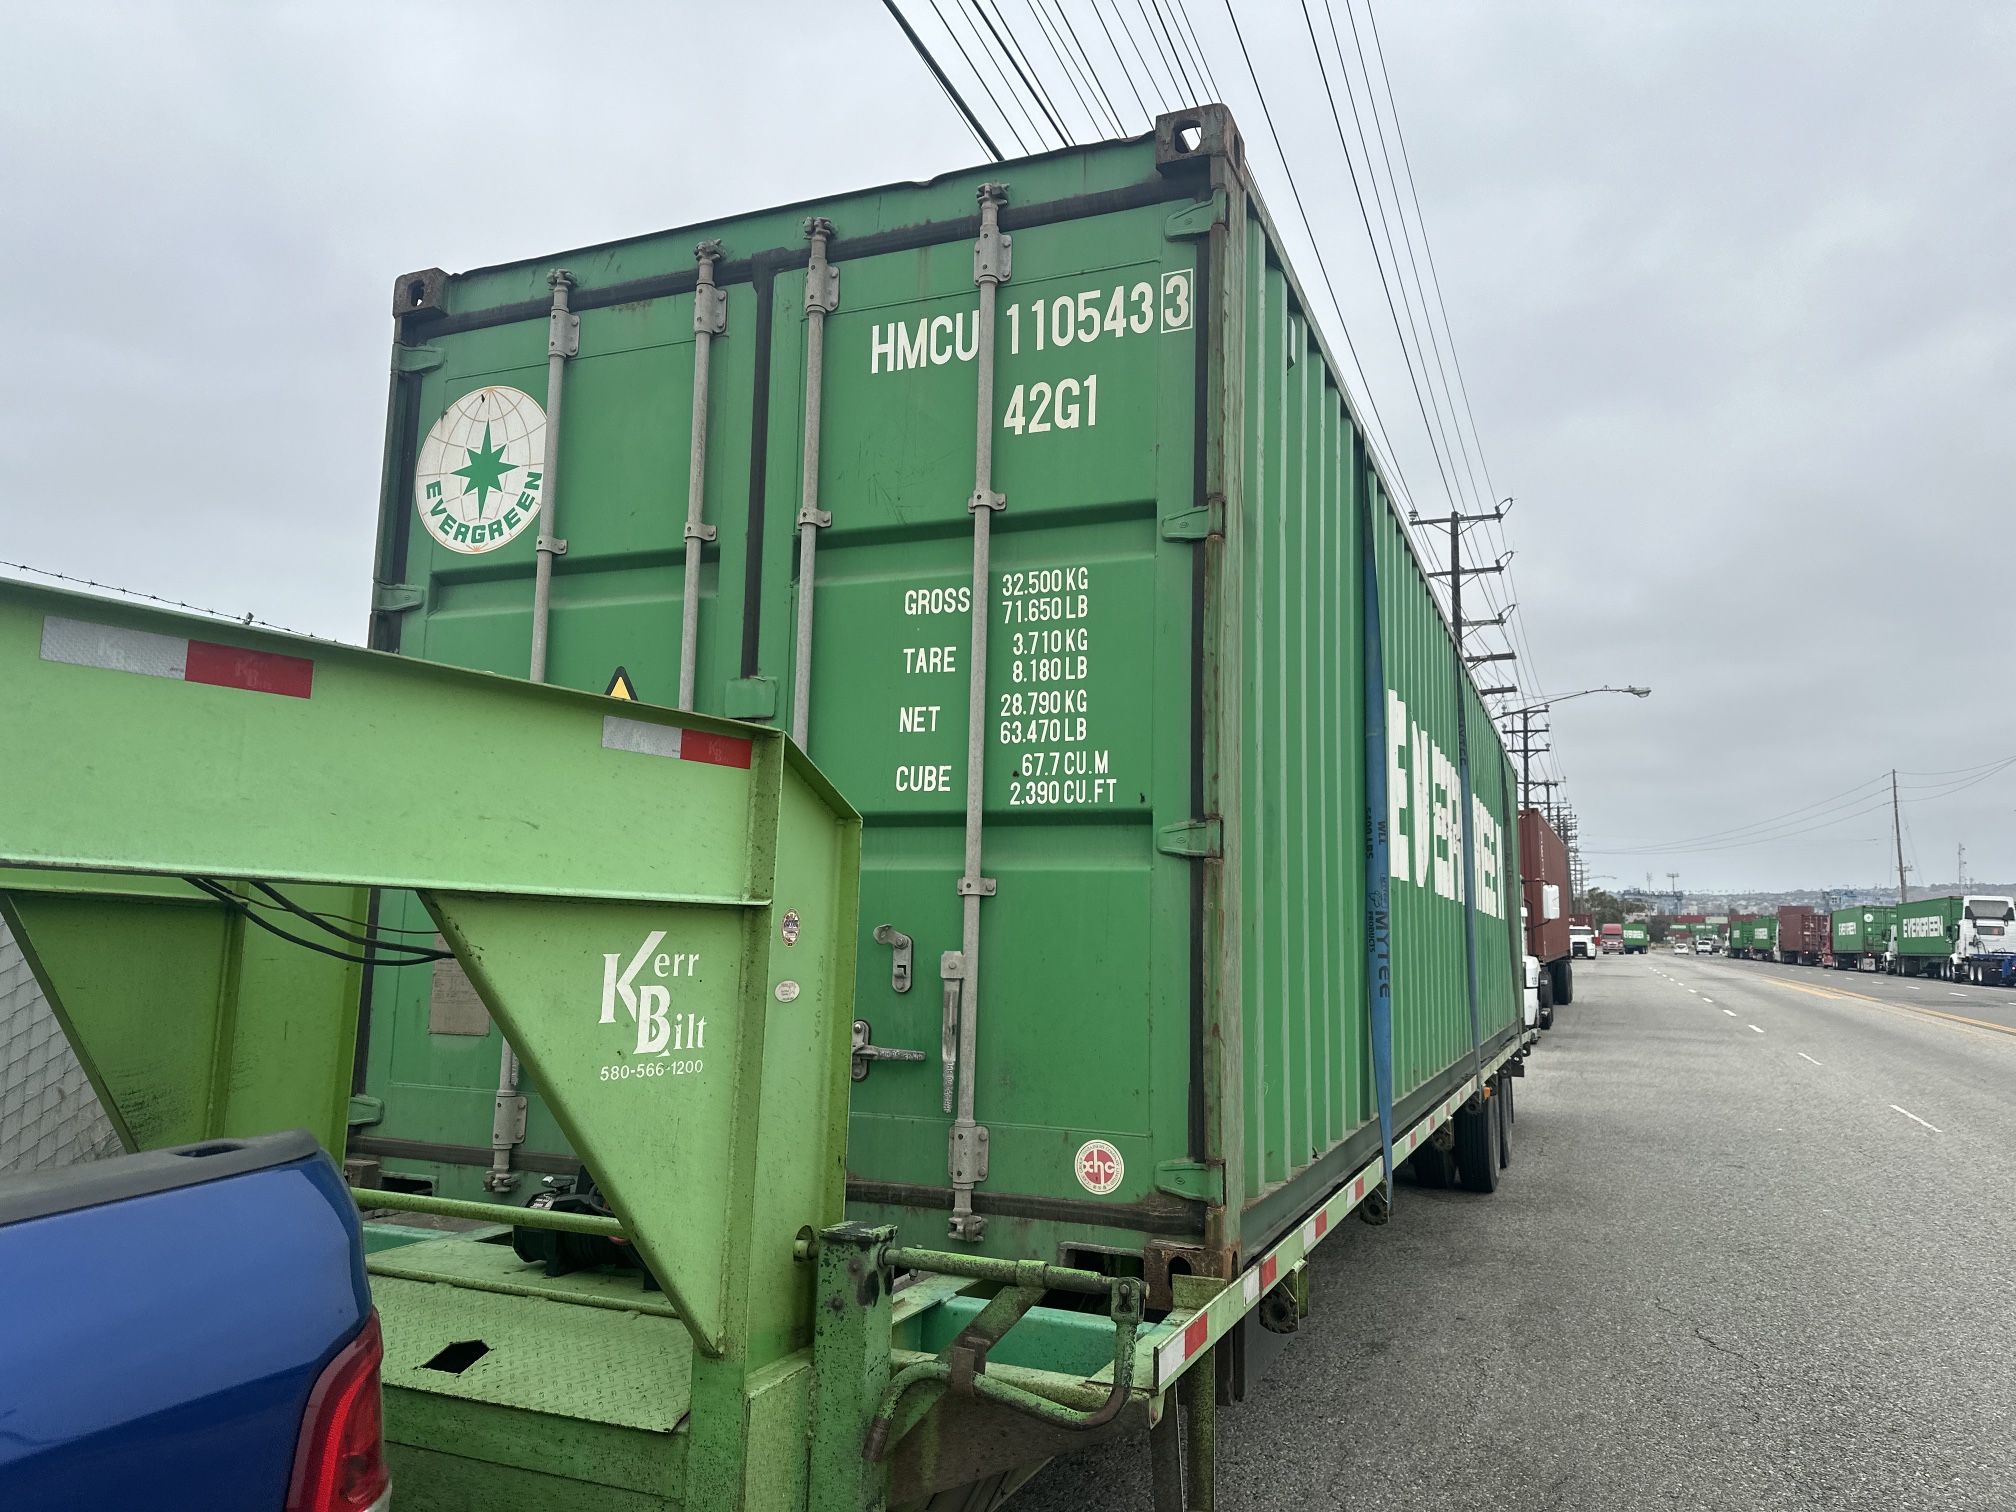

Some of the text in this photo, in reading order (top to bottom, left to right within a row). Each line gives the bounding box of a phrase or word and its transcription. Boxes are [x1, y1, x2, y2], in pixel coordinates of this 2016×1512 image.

[871, 273, 1191, 374] HMCU 110543 3
[1003, 374, 1097, 435] 42G1
[425, 472, 542, 543] EVERGREEN
[1002, 567, 1089, 597] 32.500 KG
[904, 587, 971, 616] GROSS
[1002, 595, 1089, 624] 71.650 LB
[1012, 628, 1088, 656] 3.710 KG
[903, 646, 957, 674] TARE
[1012, 656, 1088, 683] 8.180 LB
[1000, 689, 1087, 717] 28.790 KG
[899, 705, 941, 733] NET
[1000, 717, 1087, 744] 63.470 LB
[1022, 750, 1109, 777] 67.7 CU.M
[895, 765, 952, 792] CUBE
[1010, 778, 1117, 805] 2.390 CU.FT
[1388, 688, 1505, 921] EVERREEN
[1377, 820, 1386, 846] WLL
[1367, 911, 1376, 953] PRODUCTS
[1376, 911, 1390, 998] MYTEE
[598, 930, 700, 1024] Kerr
[632, 985, 708, 1058] Bilt
[600, 1059, 703, 1081] 580-566-1200
